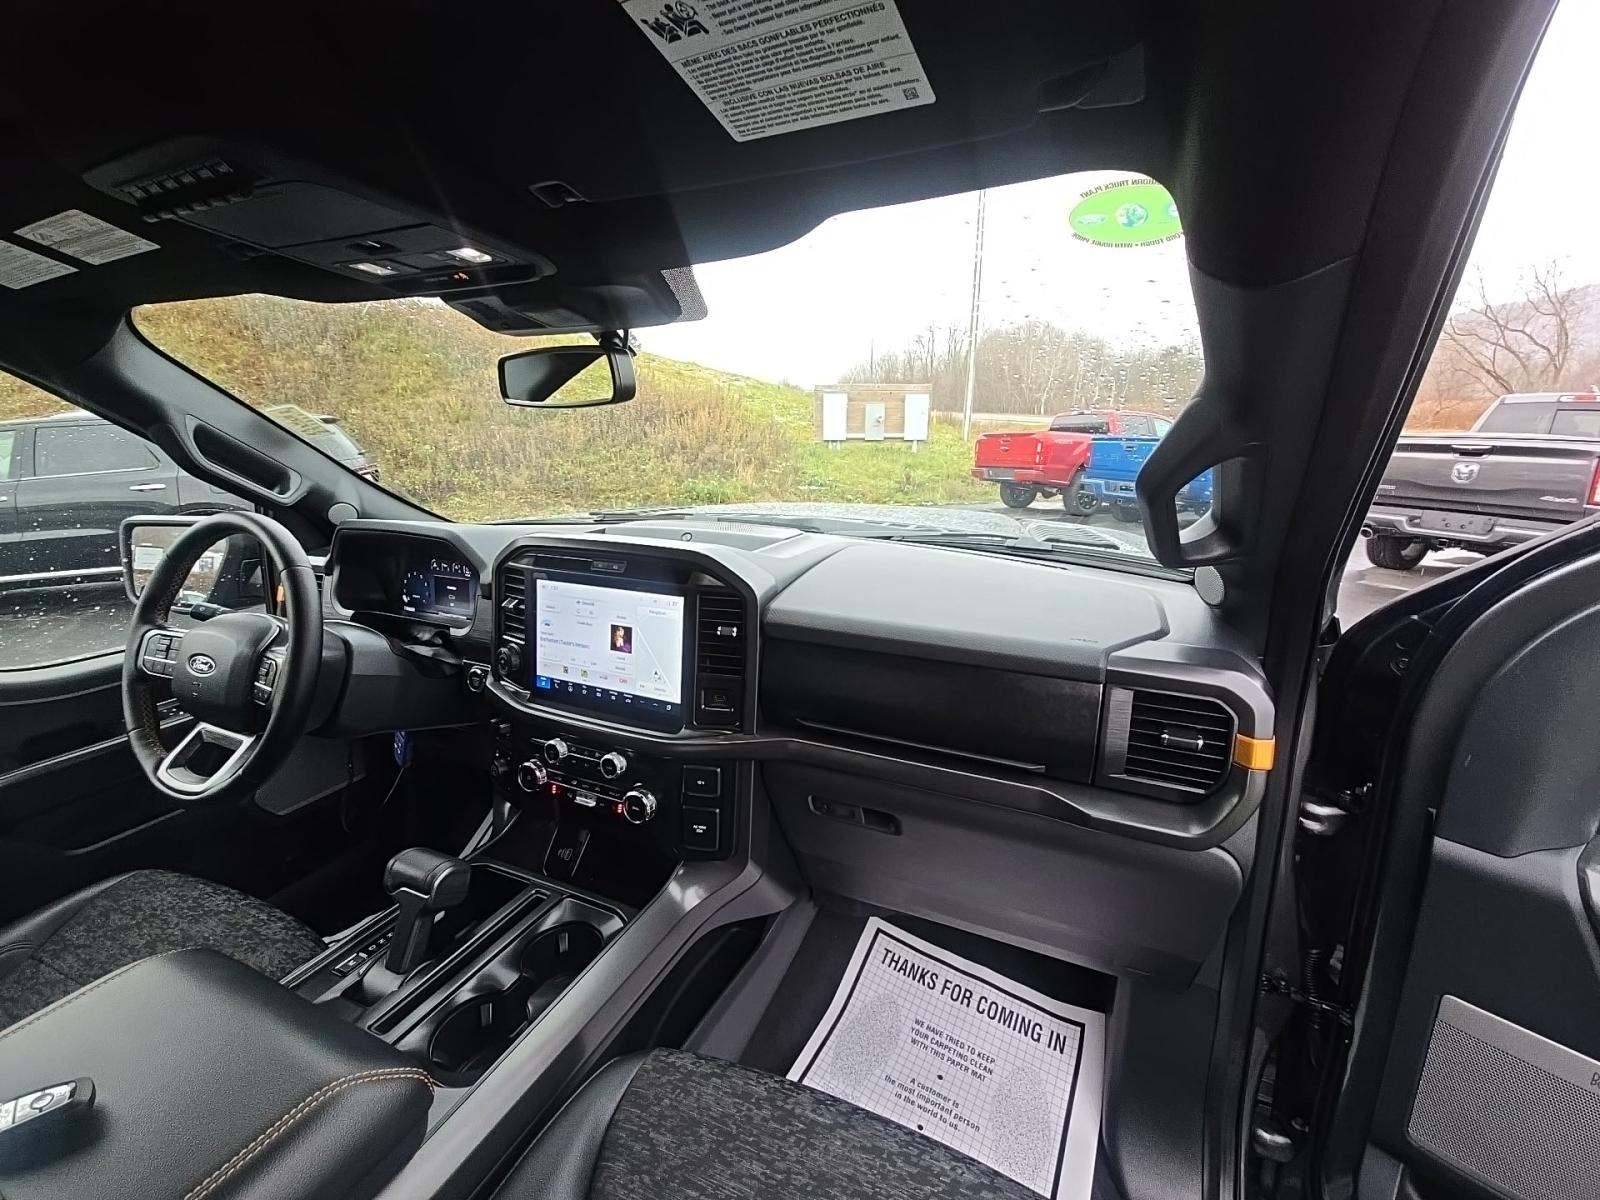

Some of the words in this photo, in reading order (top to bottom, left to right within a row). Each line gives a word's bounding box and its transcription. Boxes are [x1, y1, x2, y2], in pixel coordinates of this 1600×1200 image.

[700, 50, 722, 61] AVEC
[719, 46, 737, 56] DES
[735, 39, 759, 51] SACS
[757, 23, 813, 45] GONFLABLES
[810, 0, 885, 29] PERFECTIONNÉS
[721, 92, 758, 106] INCLUSIVE
[755, 88, 774, 97] CON
[772, 85, 789, 93] LAS
[788, 77, 820, 90] NUEVAS
[819, 69, 853, 82] BOLSAS
[851, 66, 866, 75] DE
[865, 61, 887, 72] AIRE
[880, 947, 939, 991] THANKS
[940, 978, 974, 1008] FOR
[975, 995, 1044, 1044] COMING
[1046, 1029, 1067, 1055] IN
[910, 1026, 929, 1041] YOUR
[930, 1036, 969, 1063] CARPETING
[969, 1057, 994, 1076] CLEAN
[910, 1036, 929, 1052] WITH
[929, 1046, 946, 1061] THIS
[946, 1055, 970, 1074] PAPER
[970, 1069, 987, 1083] MAT
[914, 1017, 925, 1028] WE
[925, 1021, 944, 1038] HAVE
[944, 1032, 965, 1050] TRIED
[967, 1044, 976, 1056] TO
[976, 1050, 996, 1065] KEEP
[884, 1074, 896, 1086] the
[896, 1081, 916, 1097] most
[916, 1090, 954, 1117] important
[953, 1111, 981, 1133] person
[909, 1077, 917, 1086] A
[916, 1081, 955, 1106] customer
[952, 1099, 960, 1109] is
[1590, 1071, 1600, 1089] B
[894, 1090, 902, 1101] in
[903, 1094, 916, 1107] the
[916, 1102, 939, 1119] world
[939, 1113, 948, 1124] to
[948, 1120, 961, 1132] us.
